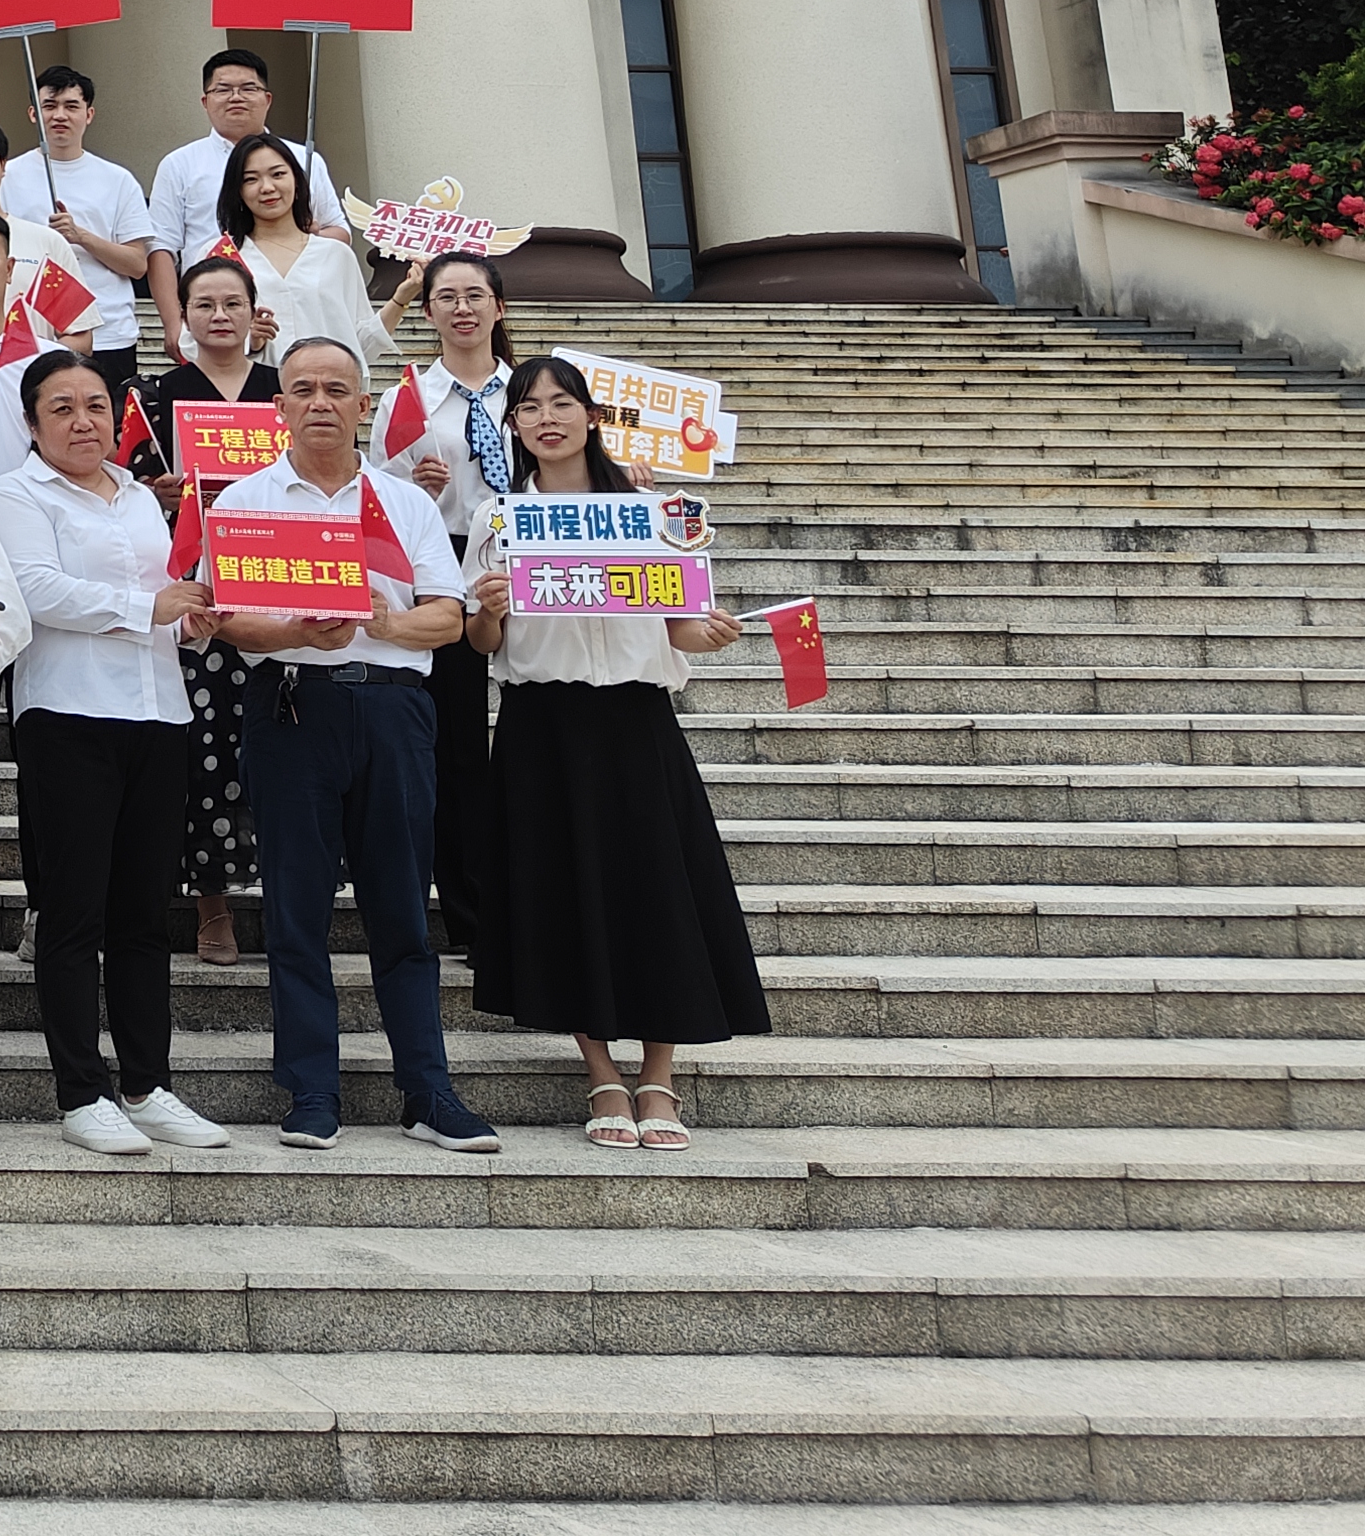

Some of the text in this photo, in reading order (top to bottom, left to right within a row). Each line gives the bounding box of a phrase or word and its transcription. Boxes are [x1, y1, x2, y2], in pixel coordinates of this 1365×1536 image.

[372, 200, 495, 240] 不忘初心
[573, 362, 709, 428] 月共回首
[599, 402, 641, 429] 前程
[194, 428, 292, 450] 工程造价
[512, 503, 653, 541] 前程似锦
[216, 554, 364, 587] 智能建造工程
[529, 562, 686, 607] 未来可期
